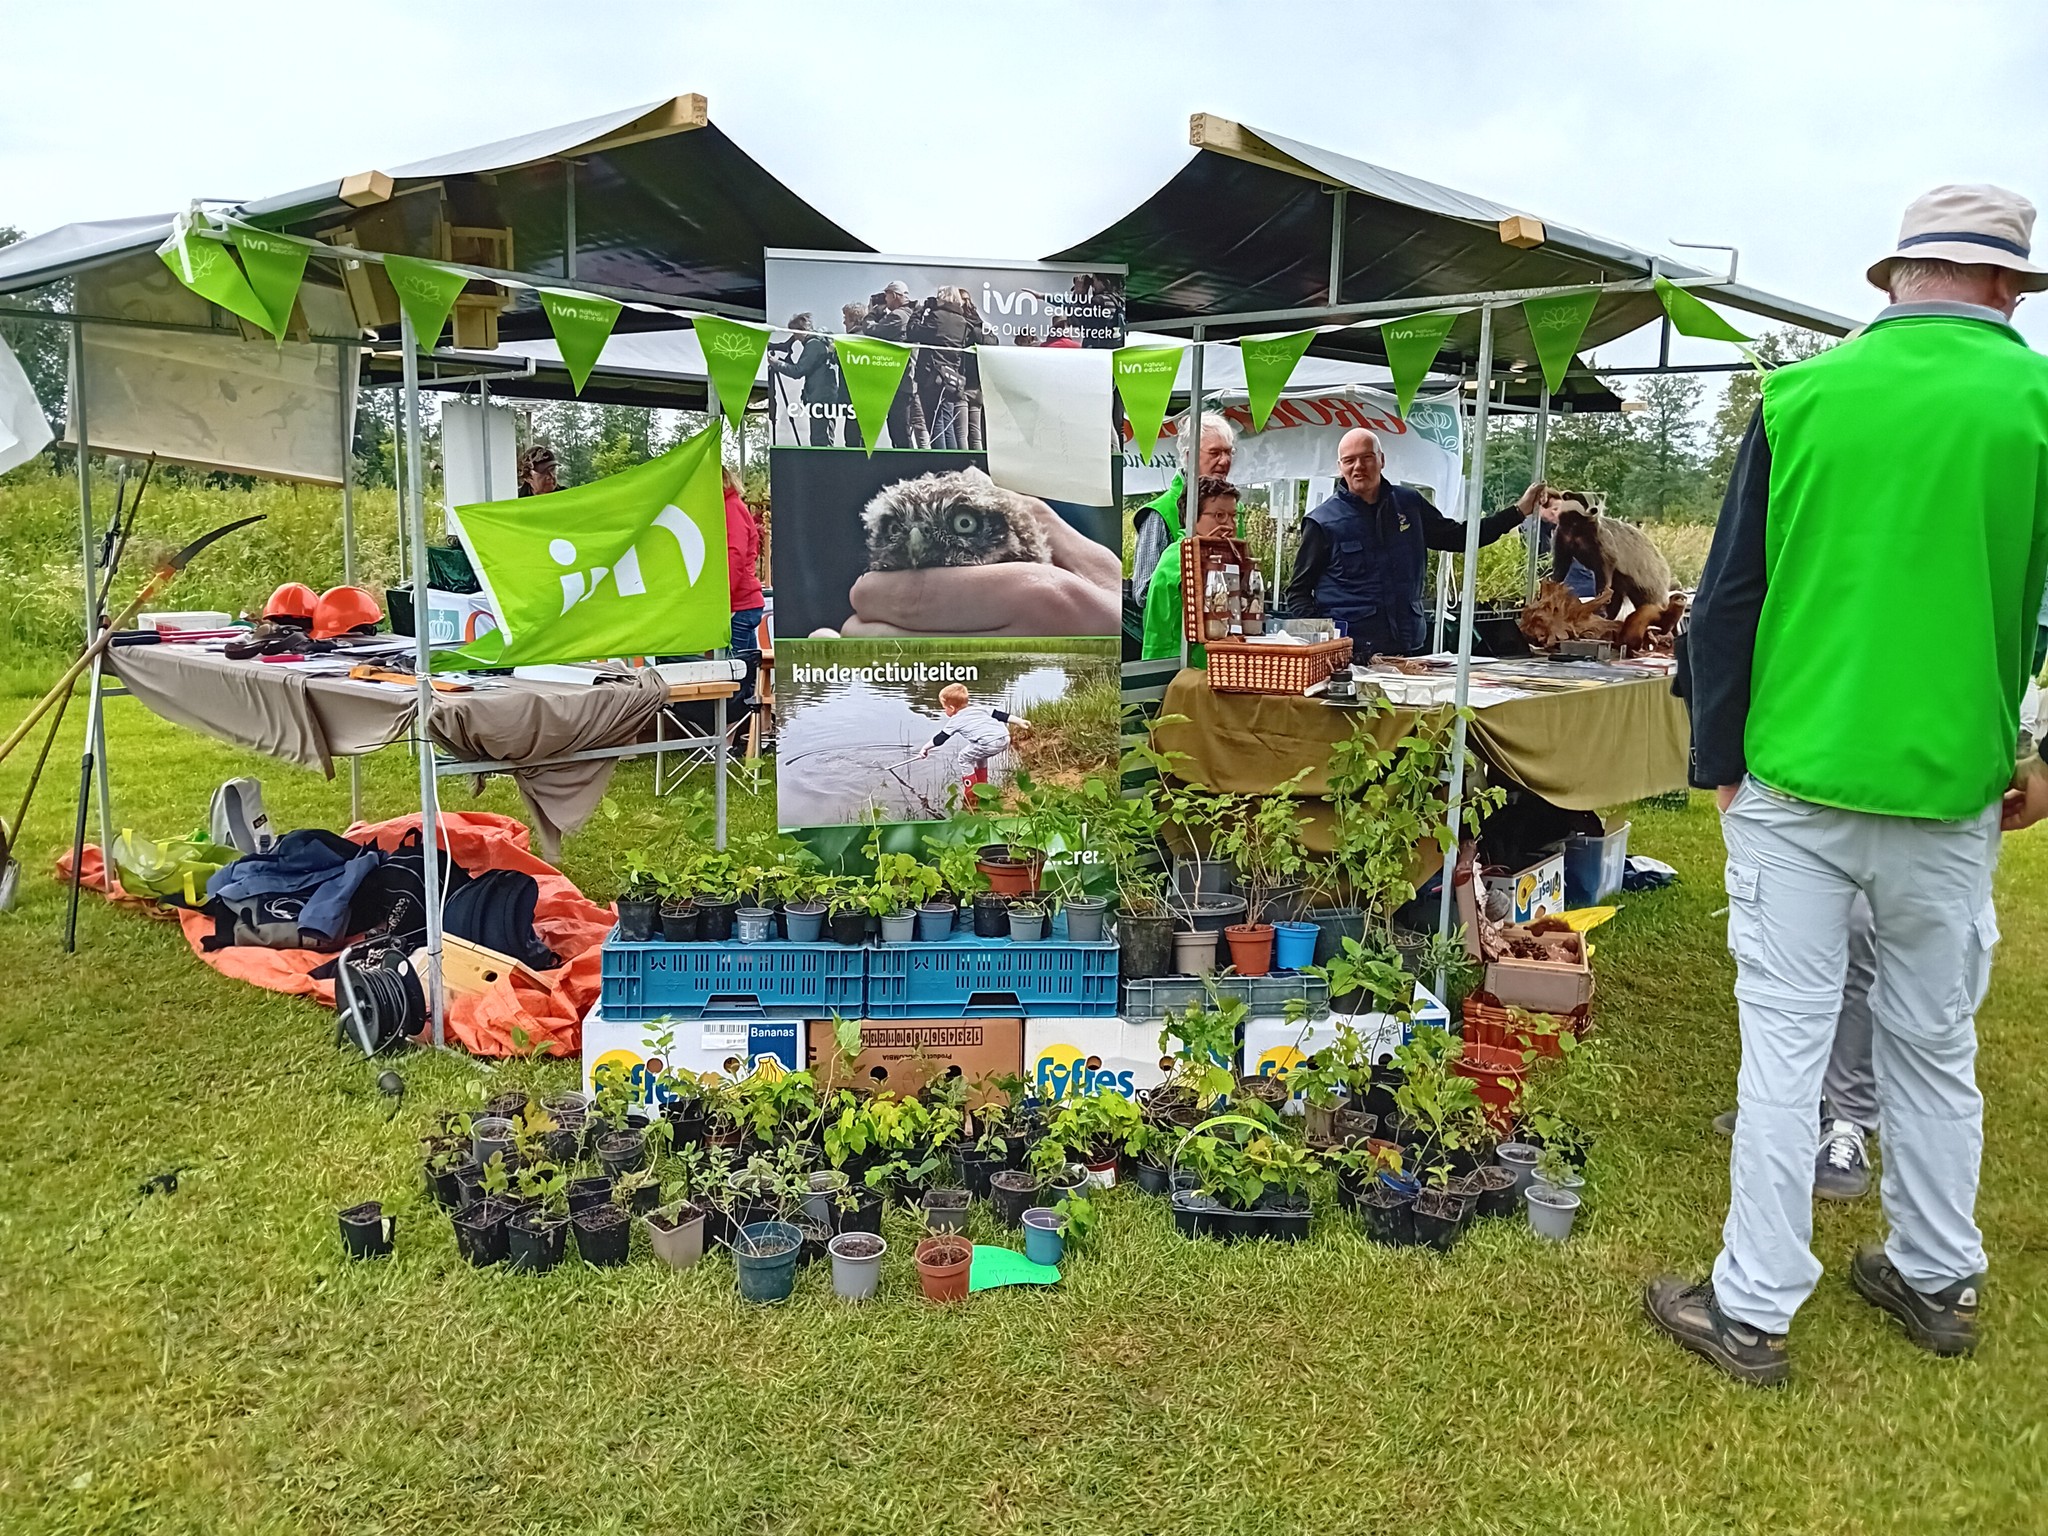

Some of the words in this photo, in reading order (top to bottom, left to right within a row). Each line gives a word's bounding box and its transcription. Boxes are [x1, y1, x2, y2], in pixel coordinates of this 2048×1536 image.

[242, 234, 268, 251] ivn
[982, 281, 1038, 316] ivn
[1045, 291, 1094, 304] natuur
[552, 301, 577, 318] ivn
[579, 308, 601, 317] natuur
[1044, 304, 1112, 318] educatie
[579, 315, 609, 323] educatie
[981, 323, 999, 336] De
[1002, 323, 1037, 337] Oude
[1040, 324, 1112, 339] IJsselstreek
[1391, 328, 1413, 340] ivn
[846, 350, 870, 366] ivn
[1119, 360, 1142, 374] ivn
[787, 402, 858, 420] excurs
[792, 661, 978, 683] kinderactiviteiten
[751, 1027, 795, 1038] Bananas
[906, 1032, 912, 1042] 9
[914, 1032, 920, 1042] 8
[923, 1031, 929, 1042] 7
[932, 1031, 937, 1042] 6
[940, 1031, 946, 1042] 5
[949, 1031, 955, 1042] 4
[957, 1031, 964, 1042] 3
[966, 1031, 972, 1042] 2
[974, 1031, 980, 1042] 1
[882, 1053, 917, 1061] MBIA
[927, 1053, 952, 1061] Product
[1037, 1057, 1135, 1101] fyffes
